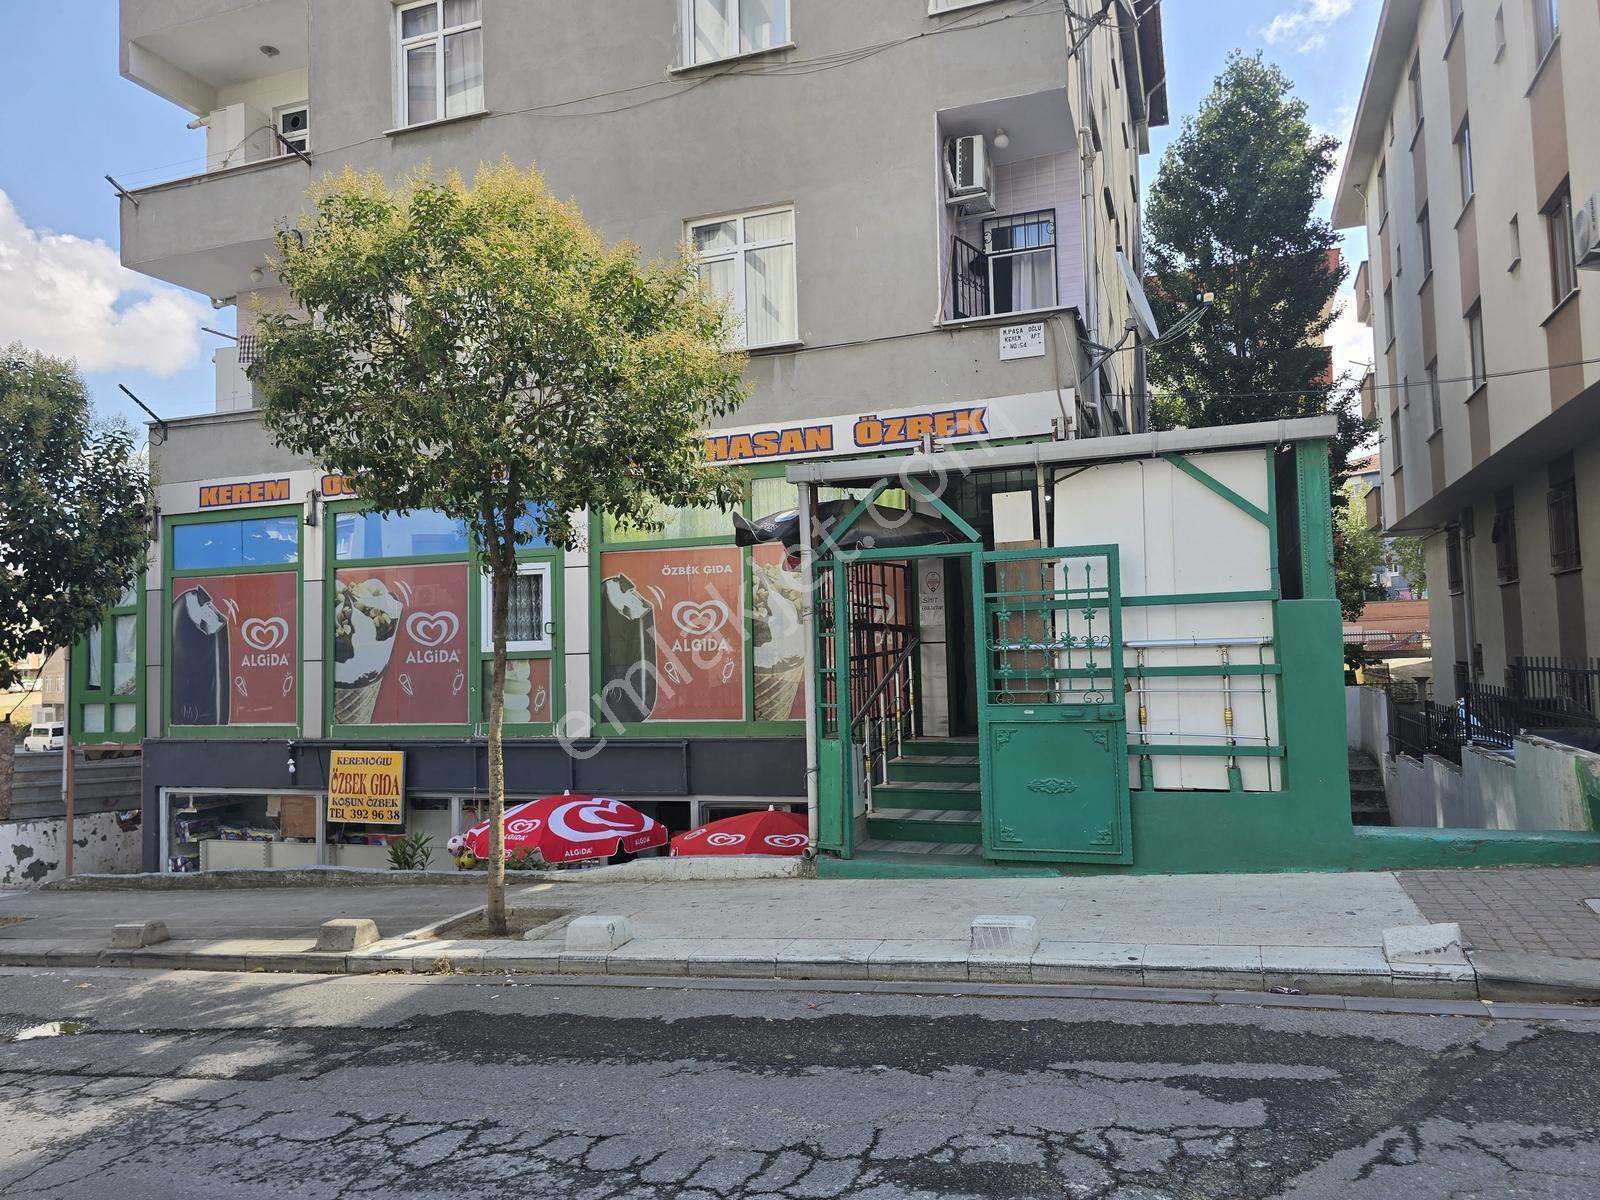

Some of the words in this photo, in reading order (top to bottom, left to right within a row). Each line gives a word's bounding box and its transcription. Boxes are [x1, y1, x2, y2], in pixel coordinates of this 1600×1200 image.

[704, 424, 833, 463] HASAN
[853, 406, 988, 447] ÖZBEK
[199, 478, 290, 507] KEREM
[661, 565, 699, 575] ÖZBEK
[703, 564, 733, 574] GIDA
[331, 768, 367, 795] ÖZBEK
[370, 773, 400, 796] GIDA
[332, 797, 364, 808] KOŞUN
[367, 796, 398, 808] ÖZBEK
[329, 808, 347, 819] TEL
[350, 809, 369, 819] 392
[371, 810, 384, 820] 96
[387, 810, 400, 820] 38
